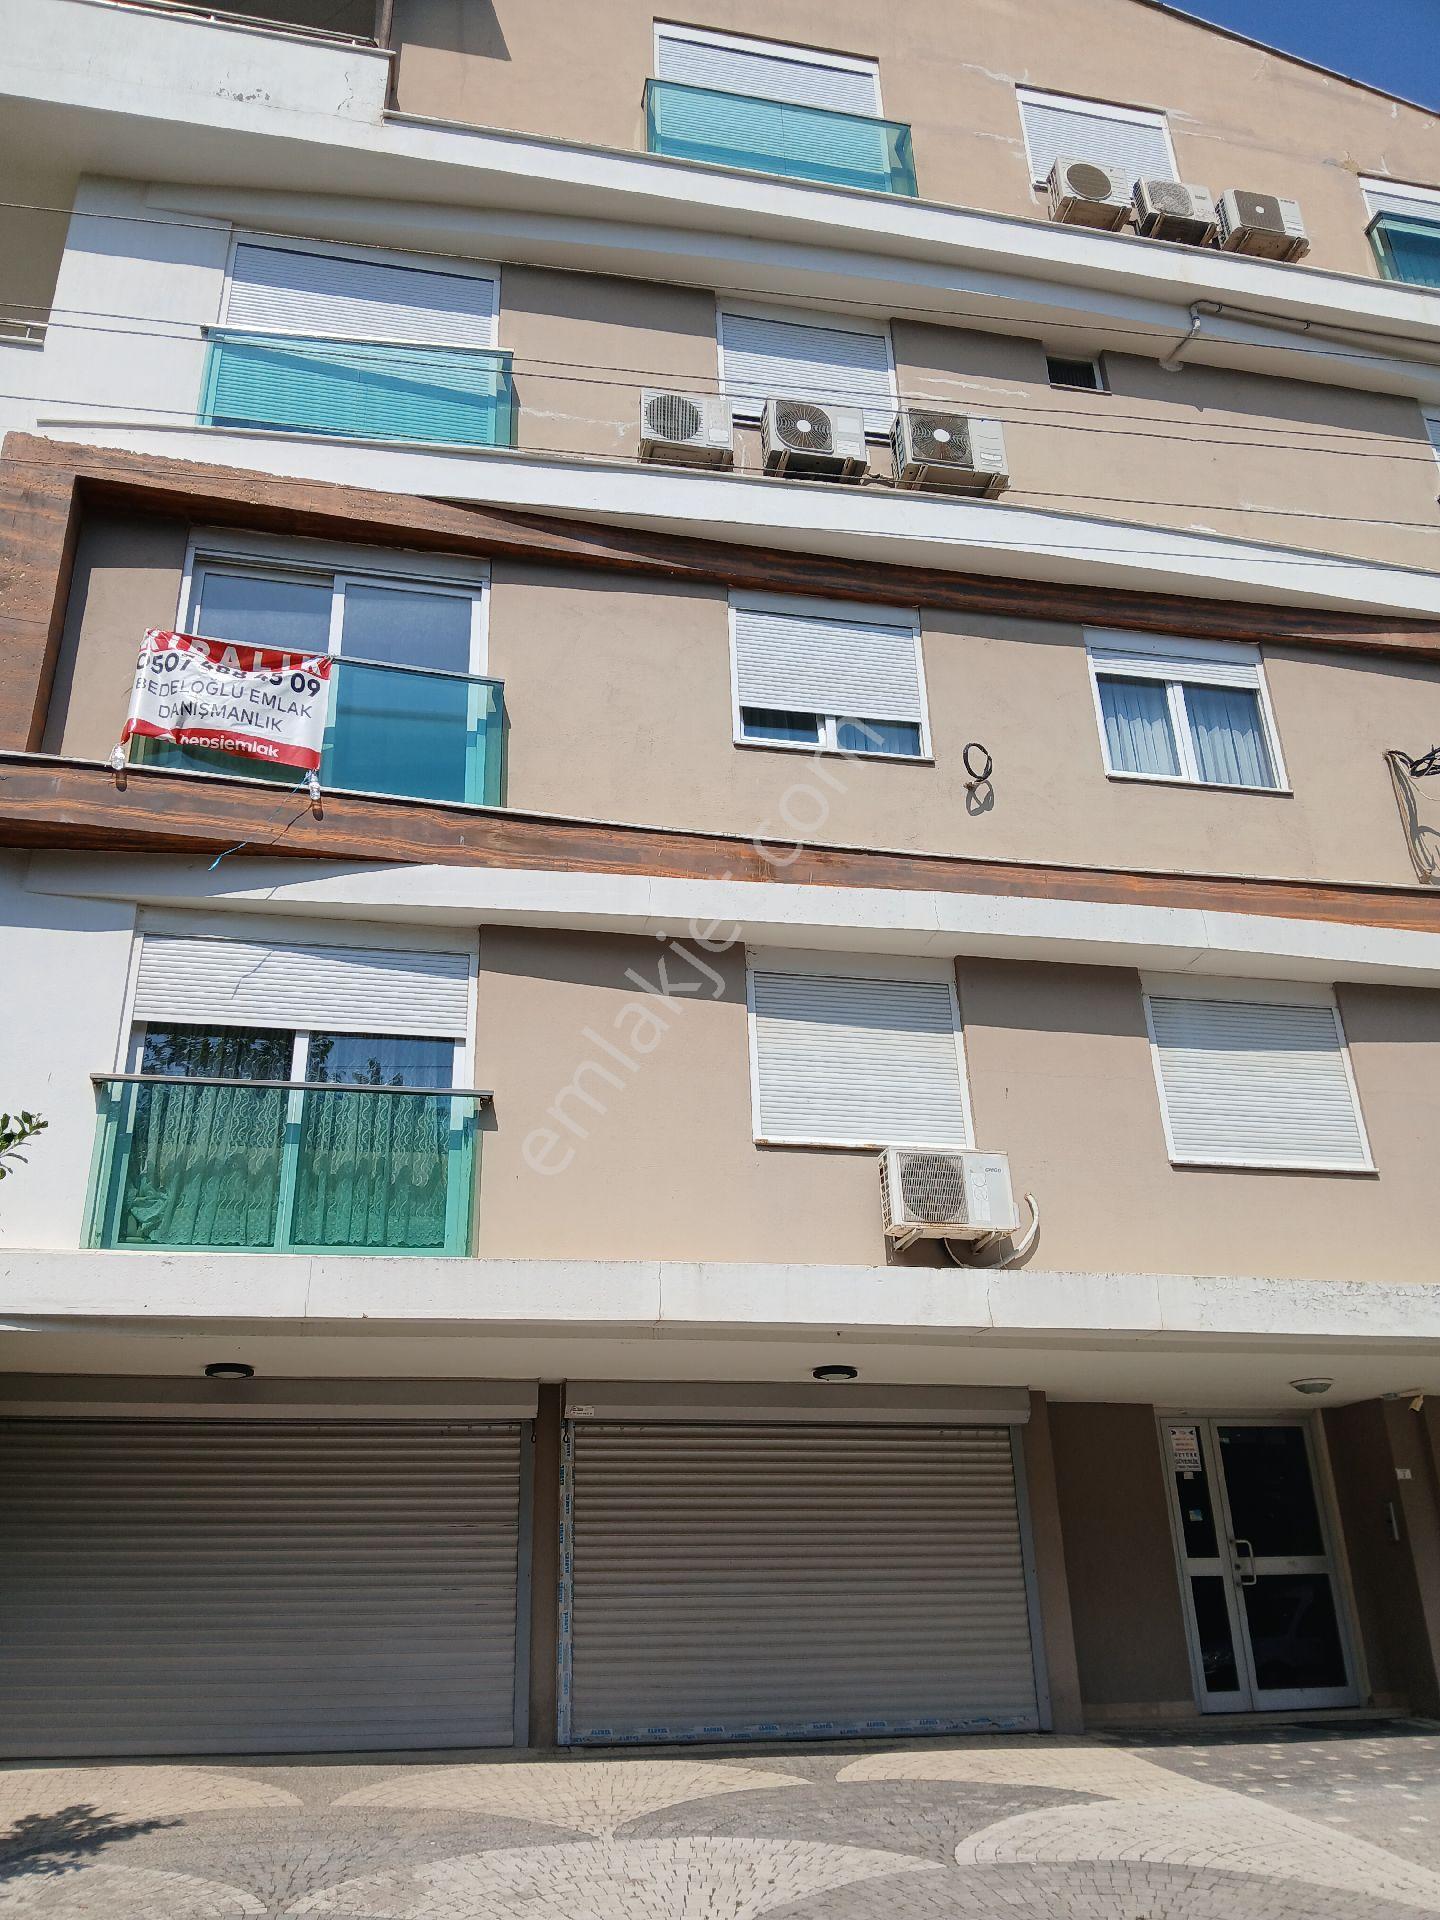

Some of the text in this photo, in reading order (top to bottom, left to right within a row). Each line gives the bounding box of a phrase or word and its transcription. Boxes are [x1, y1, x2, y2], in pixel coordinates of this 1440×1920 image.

[136, 652, 196, 674] 0507
[290, 672, 321, 697] 09
[158, 700, 284, 733] DANIŞMANLIK
[249, 688, 312, 719] EMLAK
[179, 733, 280, 759] hepsiemlak
